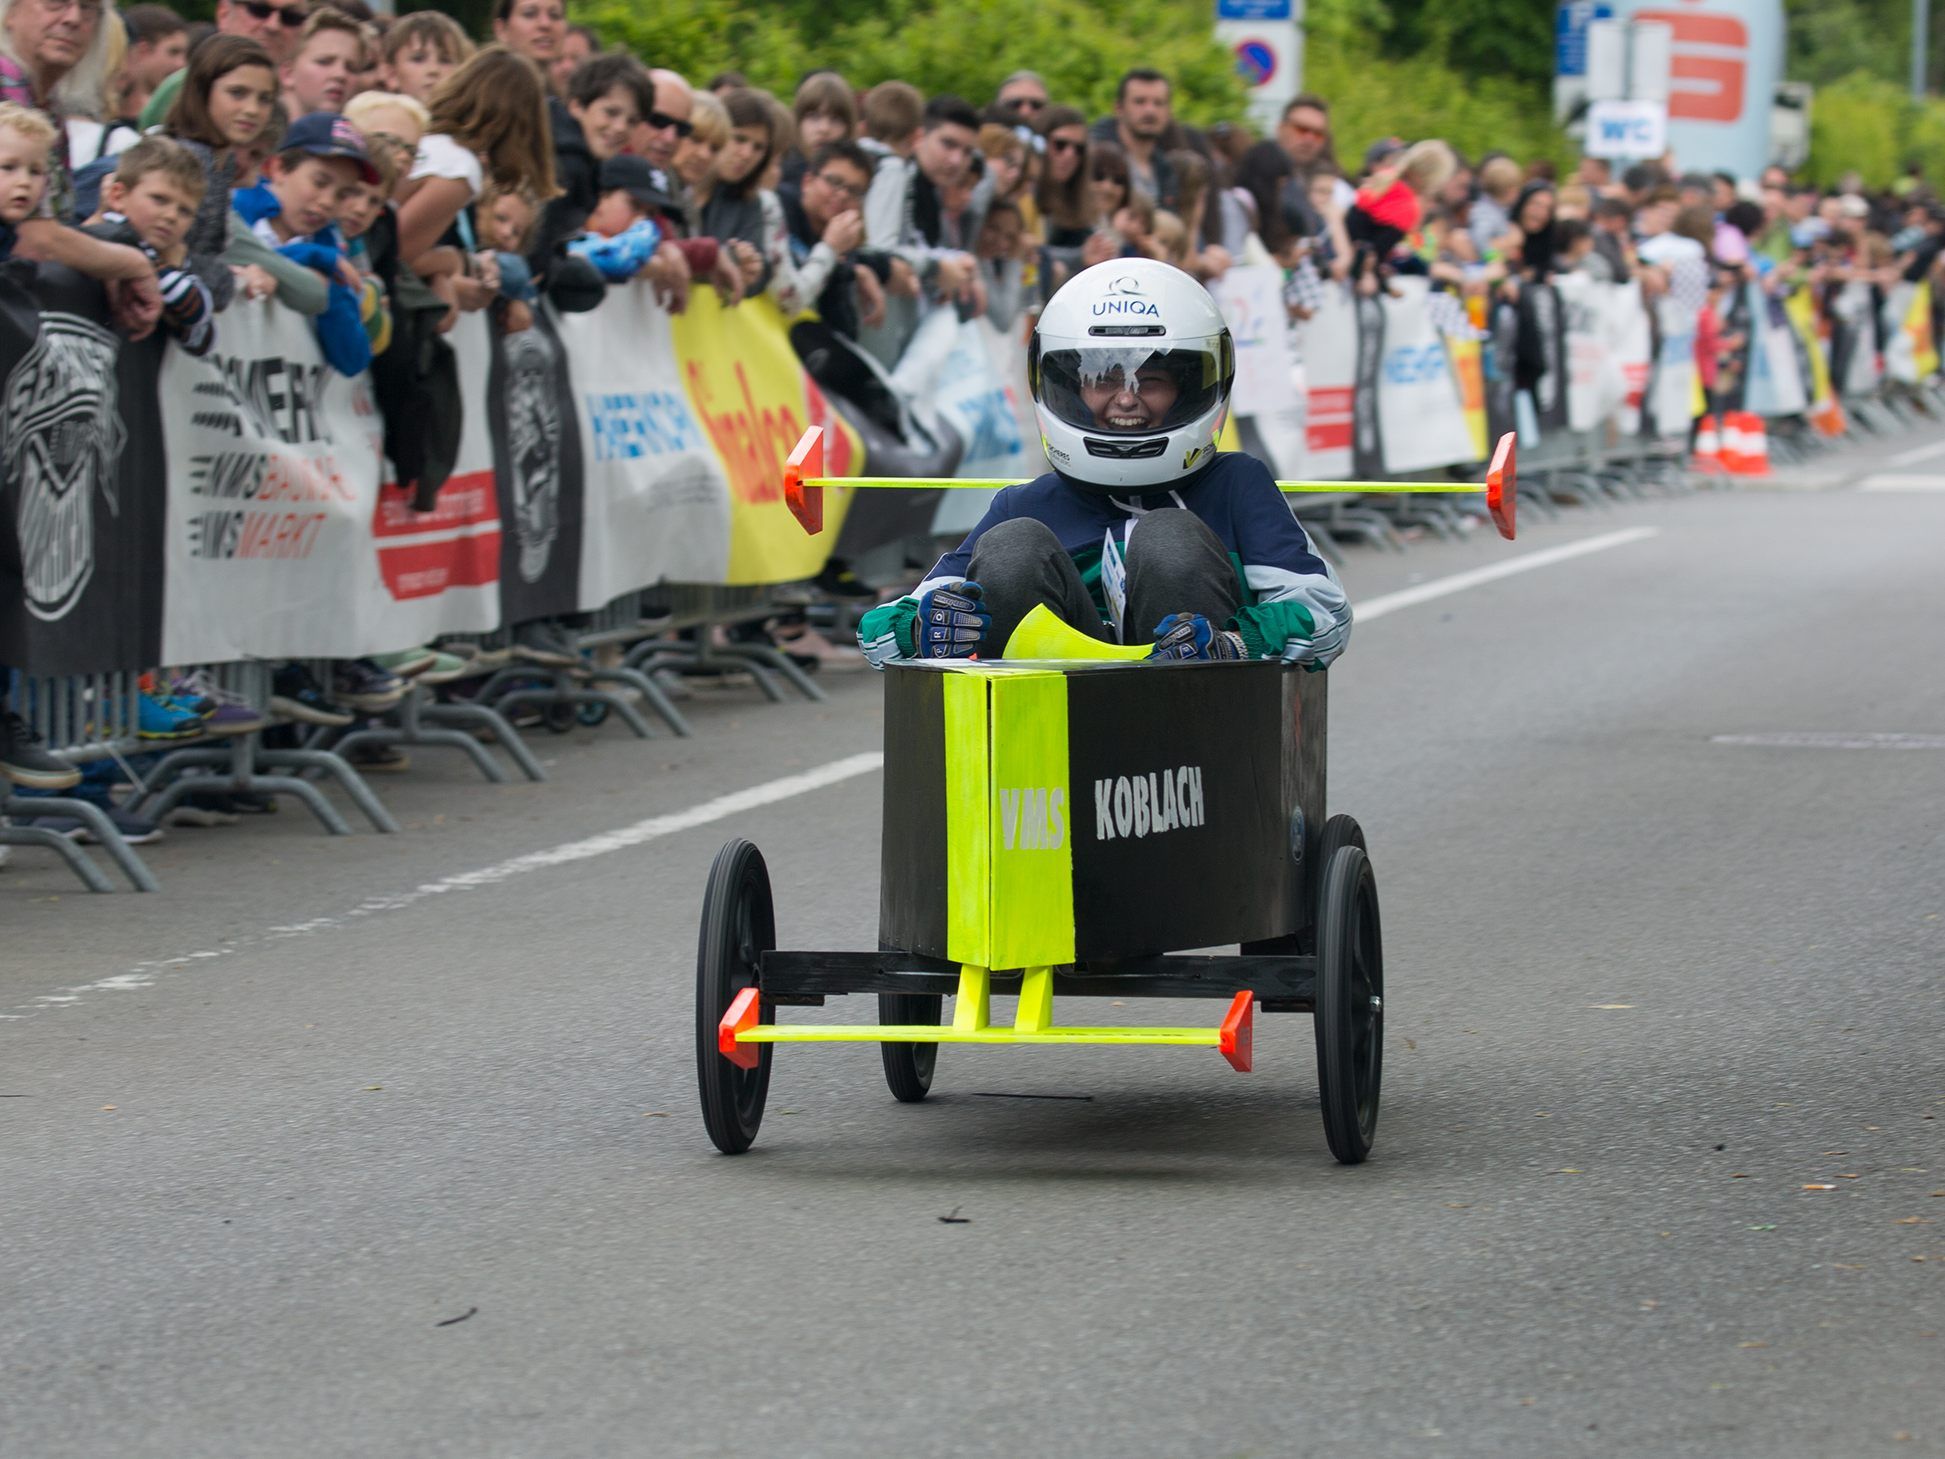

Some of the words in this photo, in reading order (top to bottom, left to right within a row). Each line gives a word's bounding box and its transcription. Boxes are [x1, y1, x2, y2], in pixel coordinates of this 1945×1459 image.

[1601, 117, 1653, 142] WC
[1093, 300, 1160, 318] UNIQA
[1000, 787, 1065, 850] VMS
[1094, 765, 1205, 841] KOBLACH
